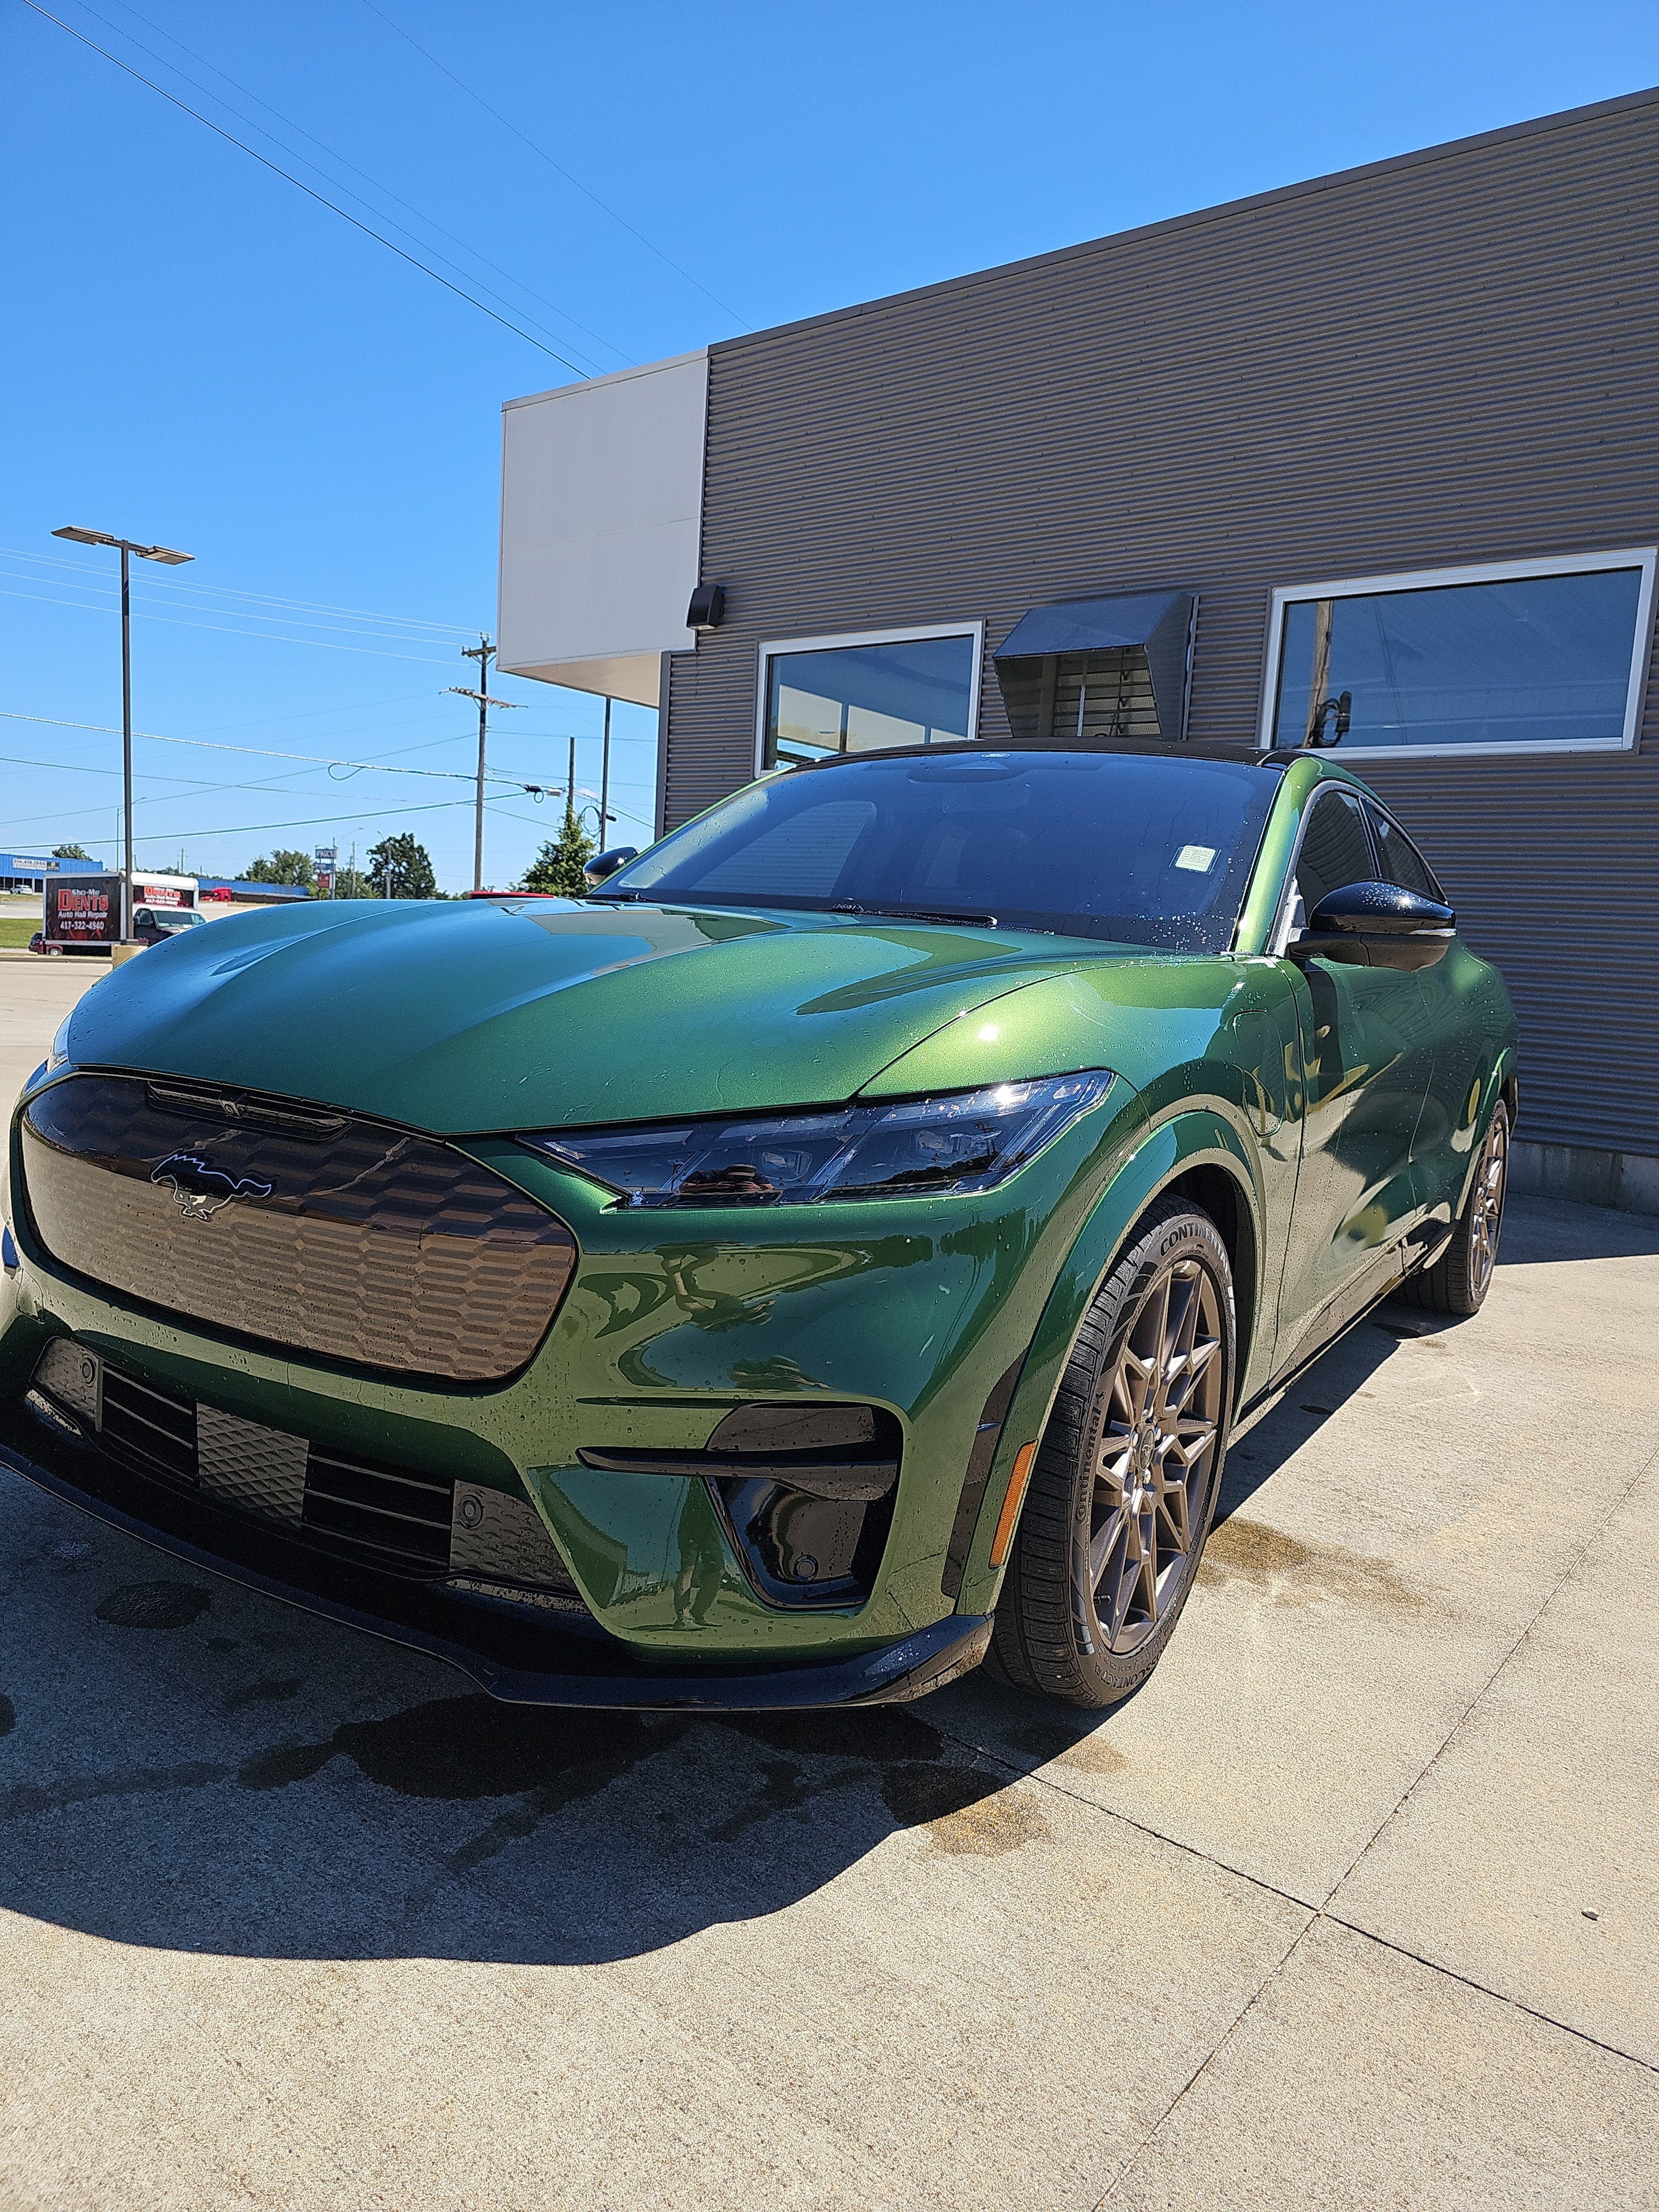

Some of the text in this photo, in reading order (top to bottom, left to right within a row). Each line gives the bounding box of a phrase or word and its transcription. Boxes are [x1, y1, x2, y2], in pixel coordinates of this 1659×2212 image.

[58, 889, 108, 911] DENTS
[87, 911, 108, 919] Repair
[1160, 1222, 1229, 1280] CONTINENTAL
[1076, 1406, 1102, 1526] Continental
